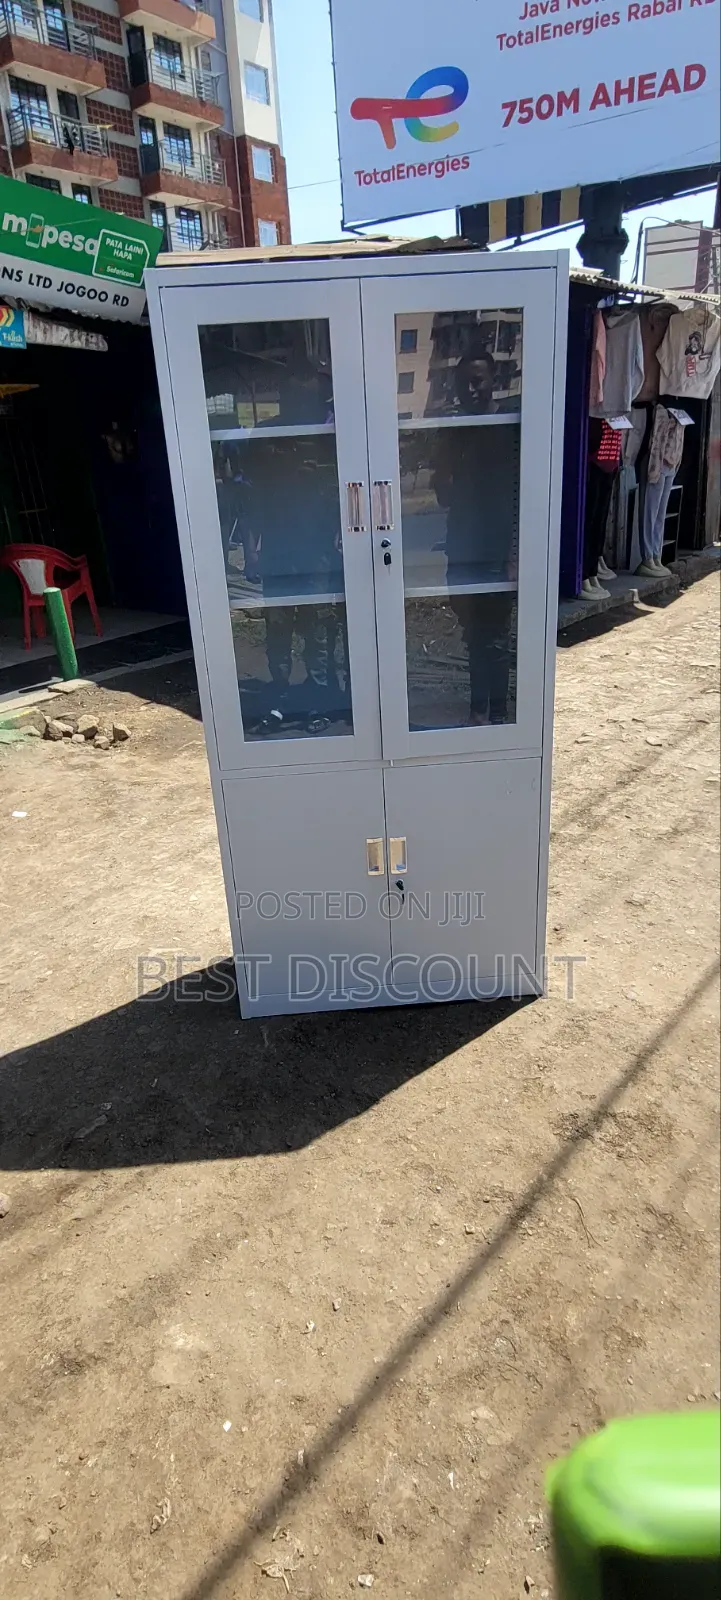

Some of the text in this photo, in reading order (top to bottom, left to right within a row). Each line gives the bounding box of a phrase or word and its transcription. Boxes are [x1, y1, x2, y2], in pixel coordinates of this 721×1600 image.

[519, 0, 560, 20] Java
[496, 10, 620, 51] TotalEnergies
[501, 63, 707, 128] 750M AHEAD
[354, 154, 470, 186] TotalEnergies
[105, 238, 123, 249] PATA
[113, 249, 132, 261] HAPA
[0, 266, 129, 307] NS LTD JOGOO RD
